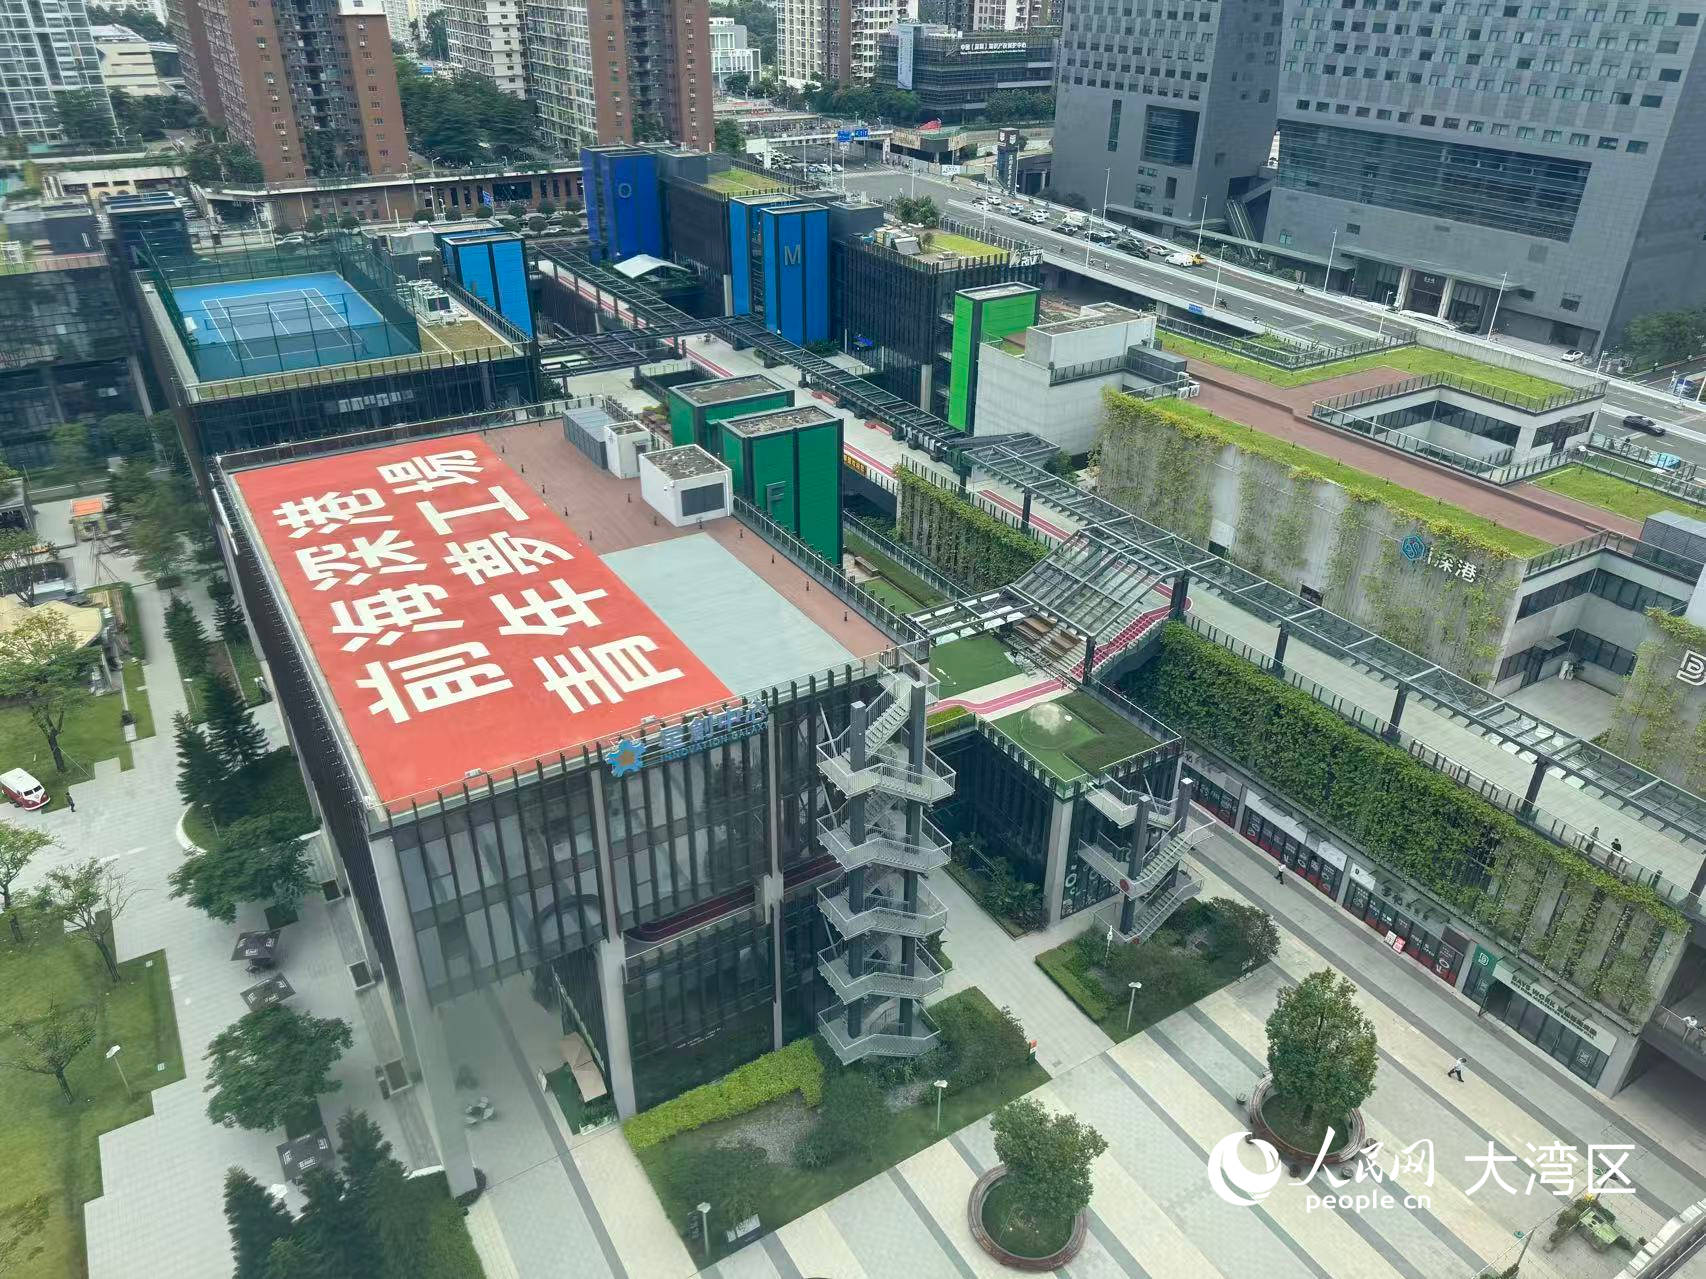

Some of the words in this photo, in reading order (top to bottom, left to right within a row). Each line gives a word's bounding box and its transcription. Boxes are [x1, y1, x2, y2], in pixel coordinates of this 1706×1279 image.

[784, 244, 801, 266] M
[766, 480, 787, 515] F
[273, 488, 514, 723] 前海深港
[376, 450, 685, 713] 青年夢工場
